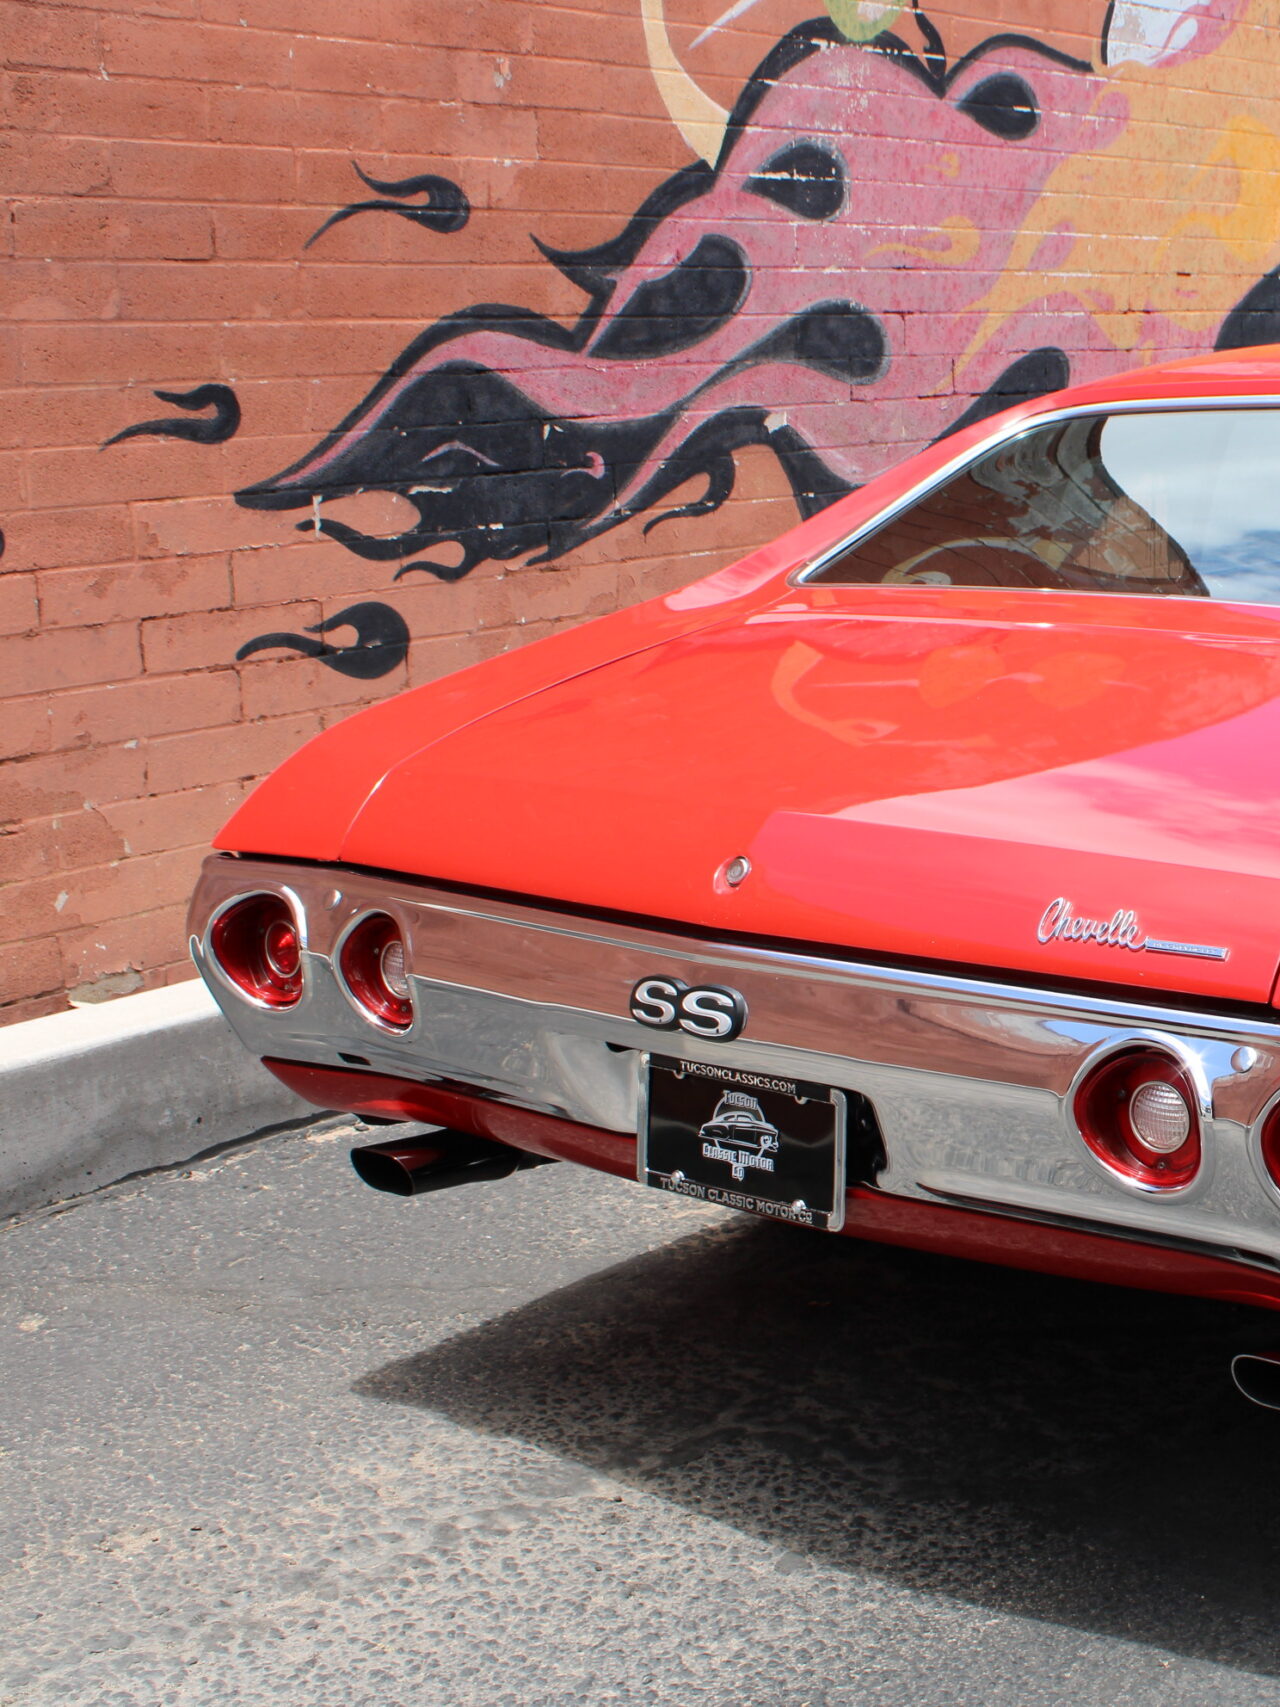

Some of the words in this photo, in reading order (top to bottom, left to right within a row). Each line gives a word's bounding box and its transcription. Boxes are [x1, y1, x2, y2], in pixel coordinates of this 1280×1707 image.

[1037, 897, 1147, 952] Chevelle
[631, 980, 735, 1037] SS
[680, 1060, 796, 1094] TUCSONCLASSICS.COM
[660, 1177, 705, 1198] TUCSON
[708, 1189, 754, 1210] CLASSIC
[756, 1199, 797, 1220] MOTOR
